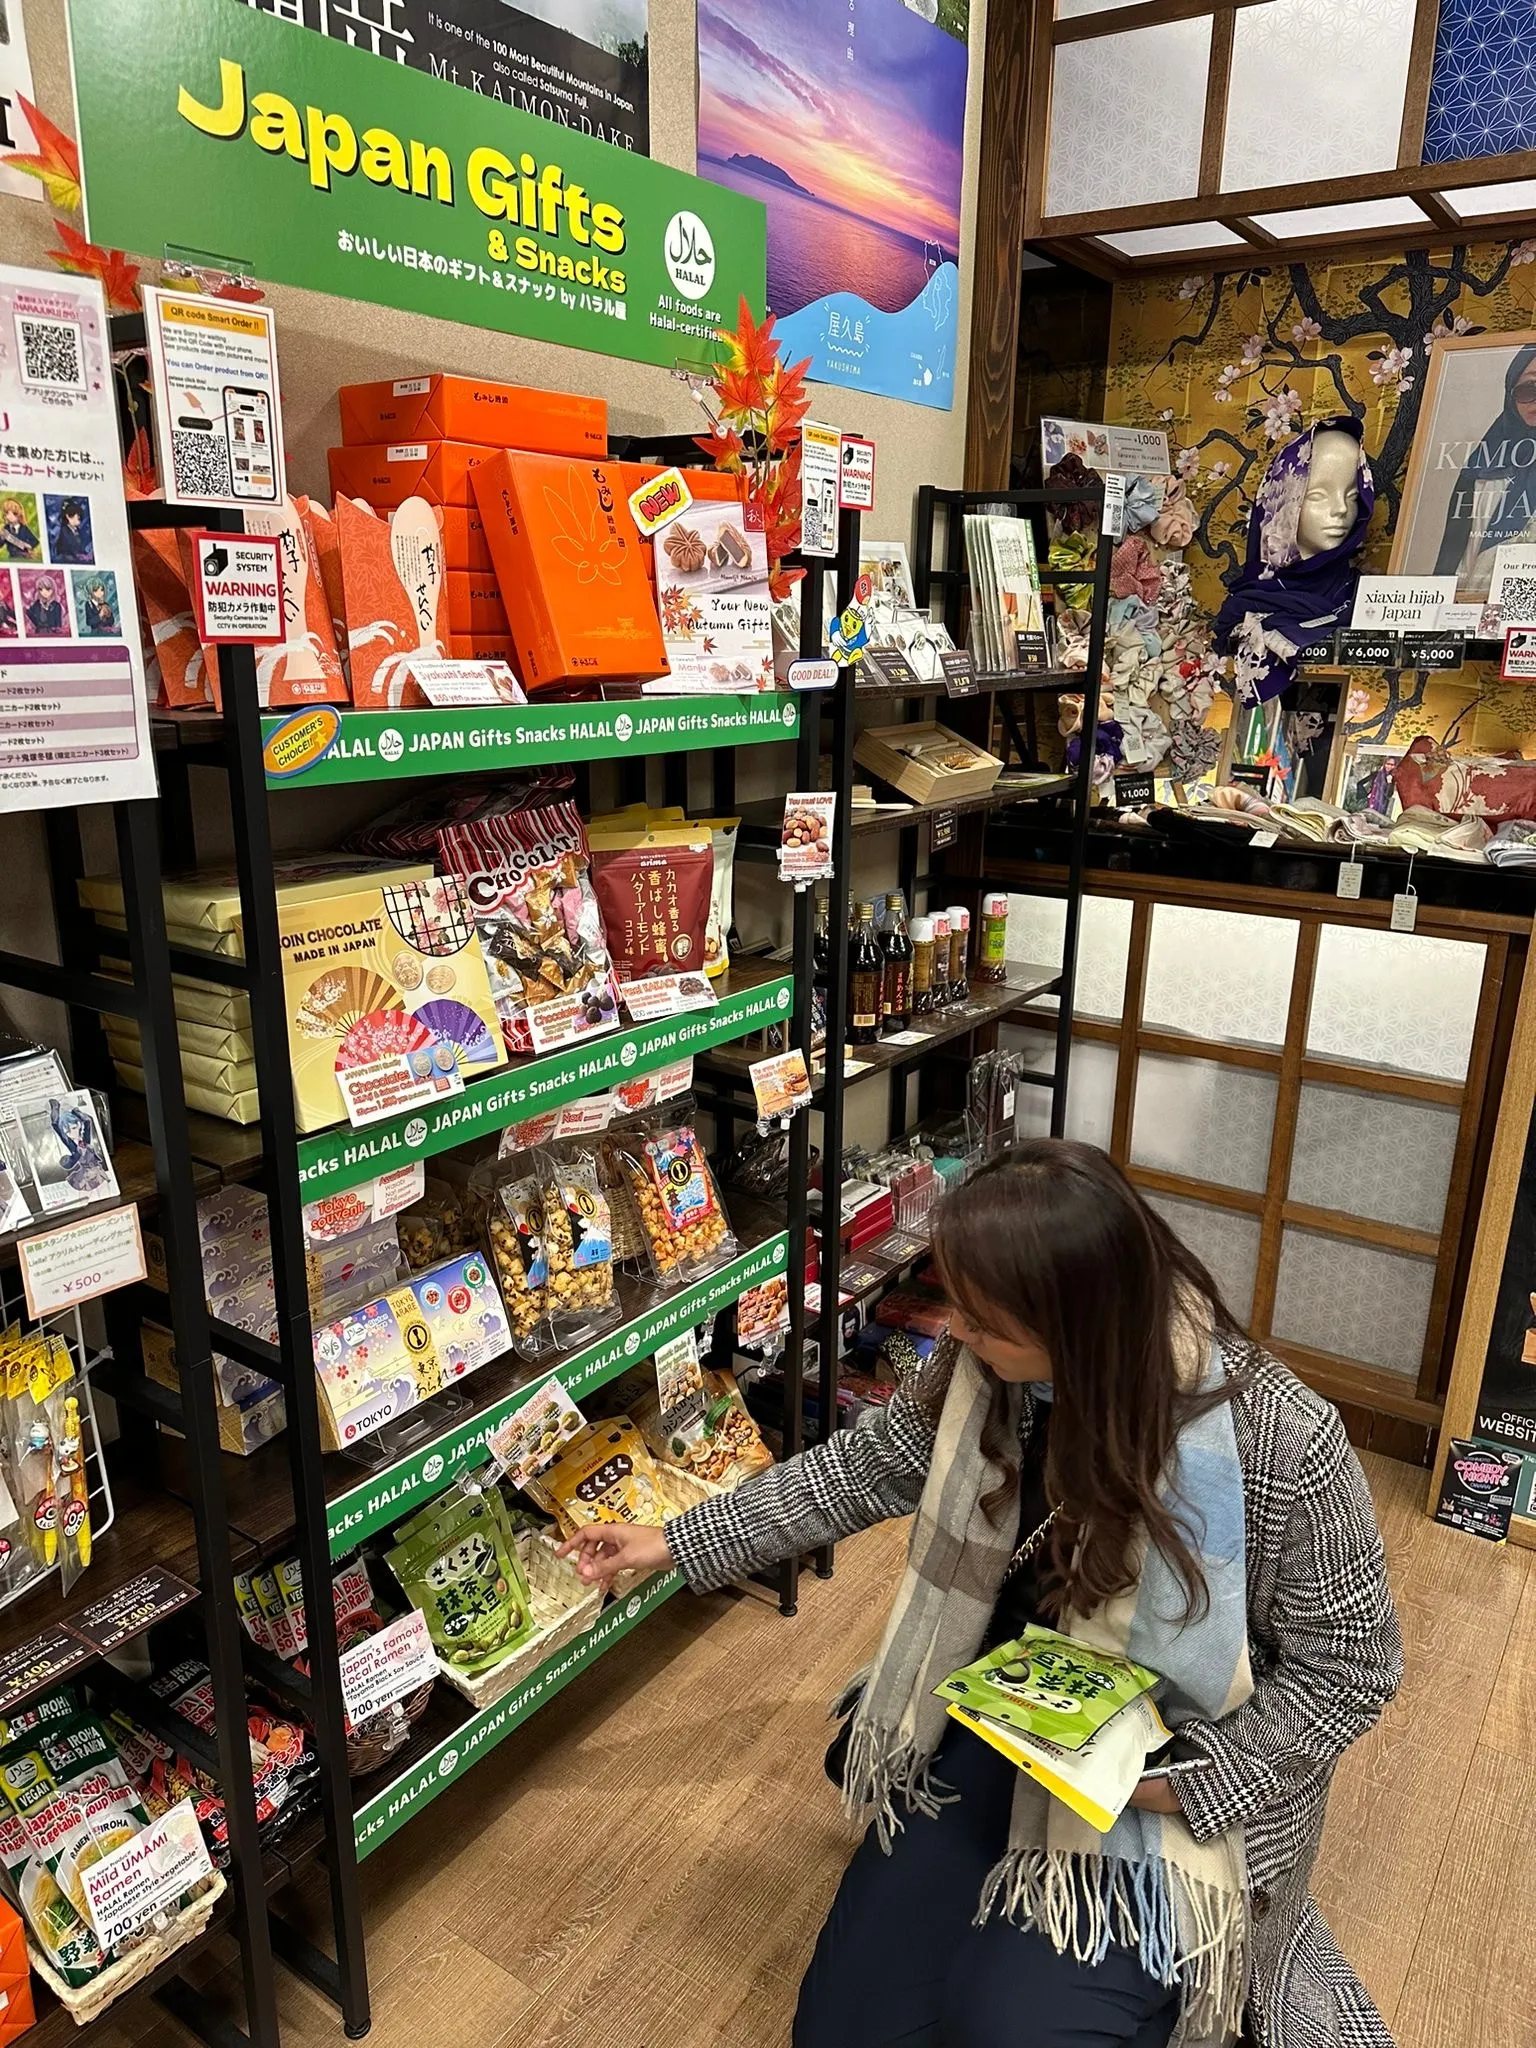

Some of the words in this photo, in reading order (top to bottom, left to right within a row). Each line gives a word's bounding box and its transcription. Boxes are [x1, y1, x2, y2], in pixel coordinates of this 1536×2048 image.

[428, 11, 435, 25] It
[436, 15, 443, 29] is
[444, 21, 463, 37] one
[464, 29, 474, 41] of
[476, 33, 490, 49] the
[492, 40, 507, 57] 100
[509, 48, 530, 66] Most
[530, 56, 565, 81] Beautiful
[566, 72, 604, 99] Mountains
[604, 89, 612, 102] in
[493, 61, 511, 76] also
[512, 68, 539, 87] called
[539, 78, 573, 104] Satsuma
[574, 93, 589, 110] Fuji.
[177, 58, 455, 205] Japan
[467, 146, 627, 255] Gifts
[337, 229, 557, 302] おいしい日本のギフト&スナック
[560, 286, 576, 311] by
[579, 292, 628, 321] ハラル屋
[487, 229, 510, 262] &
[514, 237, 628, 295] Snacks
[675, 269, 706, 287] HALAL
[171, 307, 184, 318] QR
[186, 311, 206, 321] code
[207, 314, 231, 325] Smart
[231, 318, 253, 329] Order
[658, 294, 673, 310] All
[675, 298, 703, 319] foods
[705, 310, 722, 323] are
[184, 329, 197, 337] Sorry
[827, 310, 865, 346] 屋久島
[176, 345, 199, 353] products
[195, 363, 213, 371] Order
[215, 366, 238, 376] product
[826, 359, 862, 377] YAKUSHIMA
[41, 397, 73, 407] こちらから
[843, 468, 871, 480] WARNING
[639, 482, 681, 522] NEW
[747, 509, 760, 523] 秋
[1469, 530, 1490, 539] MADE
[1491, 530, 1502, 539] IN
[1504, 530, 1531, 539] JAPAN
[236, 551, 274, 561] SECURITY
[236, 563, 267, 572] SYSTEM
[1503, 562, 1519, 570] Our
[205, 581, 276, 597] WARNING
[1365, 590, 1407, 604] xiaxia
[1408, 590, 1445, 605] hijab
[208, 601, 276, 613] 防犯カメラ作動中
[711, 598, 740, 611] Your
[744, 599, 768, 611] New
[1380, 606, 1422, 622] Japan
[687, 618, 734, 630] Autumn
[737, 618, 769, 633] Gifts
[1347, 647, 1390, 658] ¥6,000
[1411, 649, 1454, 660] ¥5,000
[678, 663, 707, 673] Manju
[791, 668, 811, 682] GOOD
[812, 667, 836, 680] DEAL!!
[272, 716, 323, 756] CUSTOMER'S
[570, 721, 613, 739] HALAL
[636, 716, 675, 735] JAPAN
[677, 715, 708, 731] Gifts
[711, 713, 747, 728] Snacks
[749, 709, 782, 724] HALAL
[277, 738, 315, 767] CHOICE!!
[409, 730, 464, 753] JAPAN
[469, 729, 512, 747] Gifts
[516, 727, 566, 743] Snacks
[1121, 786, 1150, 800] ¥1,000
[467, 834, 581, 906] CHOCOLATE
[640, 859, 668, 867] arima
[630, 872, 650, 955] バターアーモンド
[648, 870, 669, 954] 香ばし蜂蜜
[666, 869, 679, 932] カカオ香る
[307, 918, 383, 942] CHOCOLATE
[625, 920, 634, 955] ココア味
[293, 947, 326, 963] MADE
[328, 946, 341, 956] IN
[343, 937, 376, 954] JAPAN
[639, 1031, 677, 1057] JAPAN
[678, 1022, 708, 1041] Gifts
[709, 1009, 744, 1032] Snacks
[745, 995, 776, 1018] HALAL
[348, 1069, 410, 1096] Chocolates
[529, 1070, 576, 1098] Snacks
[578, 1053, 619, 1080] HALAL
[344, 1131, 402, 1166] HALAL
[431, 1100, 483, 1133] JAPAN
[486, 1084, 526, 1113] Gifts
[311, 1201, 366, 1231] souvenir
[317, 1193, 357, 1215] Tokyo
[63, 1272, 101, 1293] ¥500
[391, 1295, 414, 1310] TOKYO
[395, 1303, 418, 1318] ARARE
[368, 1313, 389, 1327] Gluten
[584, 1349, 623, 1378] HALAL
[643, 1314, 678, 1342] JAPAN
[679, 1296, 707, 1320] Gifts
[709, 1276, 741, 1300] Snacks
[743, 1255, 772, 1280] HALAL
[416, 1356, 439, 1375] 東京
[355, 1404, 392, 1434] TOKYO
[447, 1424, 495, 1465] JAPAN
[581, 1457, 629, 1499] さくさく
[582, 1457, 604, 1474] arima
[1454, 1460, 1509, 1475] COMEDY
[1463, 1470, 1503, 1485] NIGHT
[367, 1473, 421, 1514] HALAL
[432, 1538, 481, 1585] さくさく
[435, 1575, 480, 1617] 抹茶
[466, 1584, 500, 1624] 大豆
[115, 1603, 156, 1628] ¥400
[341, 1648, 381, 1678] Japan's
[383, 1623, 424, 1651] Famous
[6, 1660, 51, 1688] ¥400
[343, 1664, 372, 1688] Local
[374, 1642, 411, 1669] Ramen
[376, 1673, 392, 1686] Black
[393, 1665, 405, 1675] Soy
[345, 1683, 365, 1697] HALAL
[366, 1668, 387, 1683] Ramen
[388, 1773, 437, 1819] HALAL
[460, 1713, 506, 1757] JAPAN
[508, 1681, 544, 1716] Gifts
[545, 1645, 588, 1685] Snacks
[588, 1613, 626, 1649] HALAL
[642, 1570, 678, 1603] JAPAN
[351, 1700, 373, 1719] 700
[374, 1691, 394, 1707] yen
[67, 1726, 101, 1748] IROHA
[74, 1738, 107, 1759] RAMEN
[19, 1780, 50, 1808] VEGAN
[26, 1794, 80, 1836] Japanese
[81, 1775, 109, 1798] style
[33, 1811, 82, 1849] Vegetable
[70, 1835, 90, 1860] RAMEN
[100, 1819, 129, 1832] IROHA
[89, 1868, 119, 1895] Mild
[122, 1832, 169, 1871] UMAMI
[93, 1868, 142, 1907] Ramen
[96, 1898, 122, 1918] HALAL
[123, 1877, 150, 1898] Ramen
[142, 1878, 160, 1896] style
[104, 1916, 133, 1944] 700
[135, 1901, 157, 1924] yen
